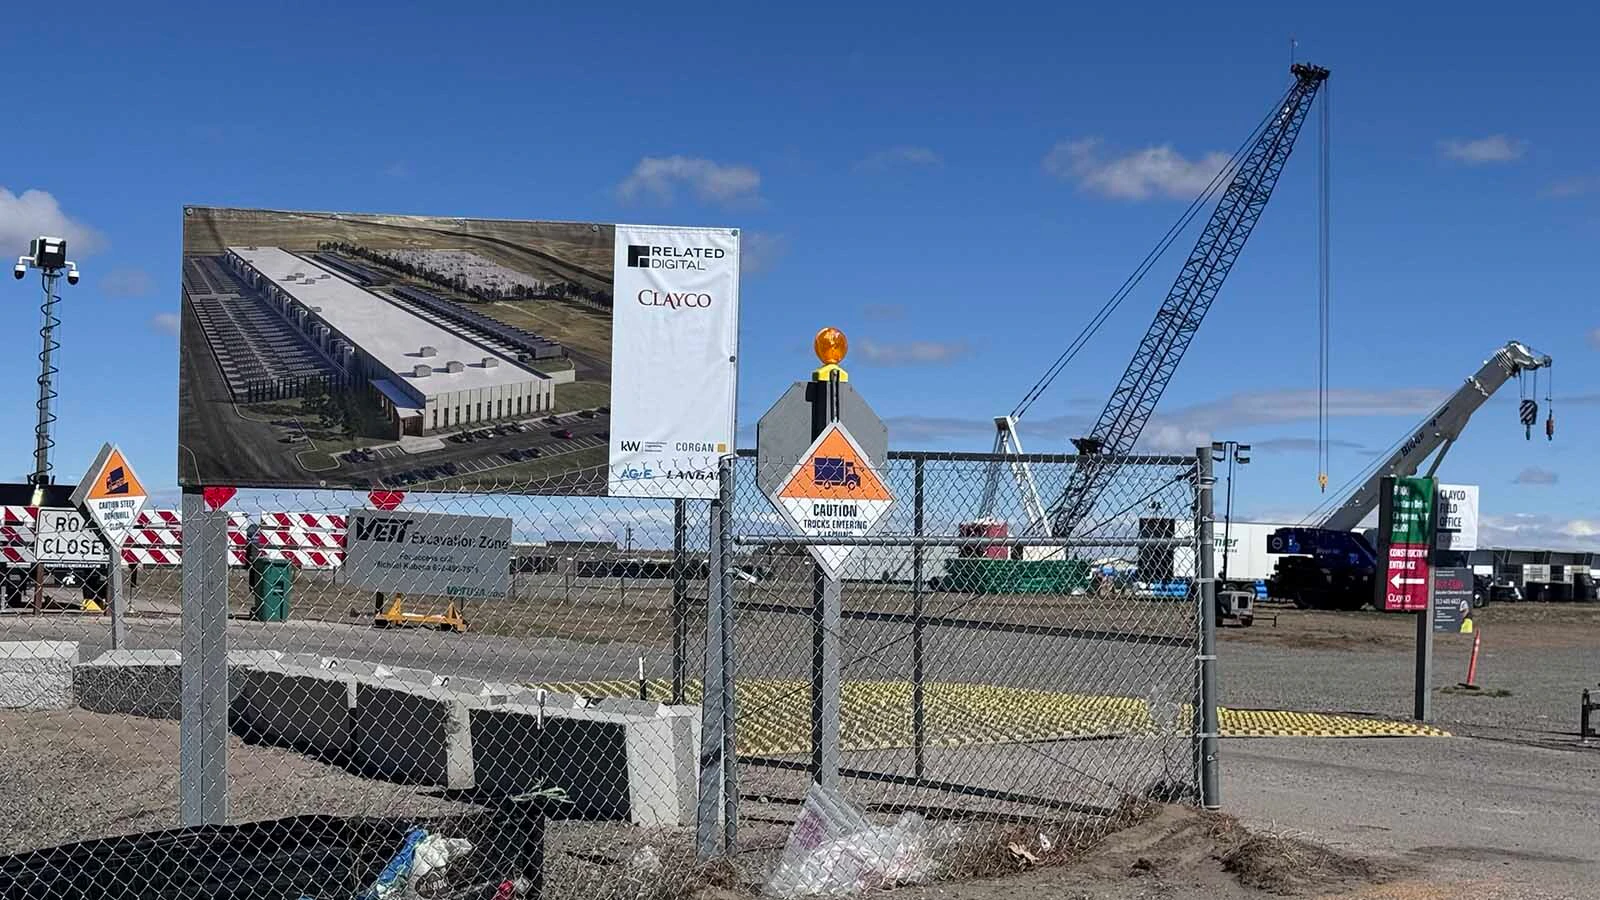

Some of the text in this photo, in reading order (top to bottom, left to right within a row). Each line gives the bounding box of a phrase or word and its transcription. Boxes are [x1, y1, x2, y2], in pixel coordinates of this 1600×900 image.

[651, 246, 725, 259] RELATED
[651, 258, 706, 271] DIGITAL
[638, 289, 712, 310] CLAYCO
[675, 442, 714, 453] CORGAN
[1440, 490, 1466, 501] CLAYCO
[813, 504, 857, 517] CAUTION
[56, 517, 84, 532] RO
[804, 519, 868, 530] TRUCKS ENTERING
[356, 515, 413, 544] VEIT
[411, 531, 475, 548] Excavation
